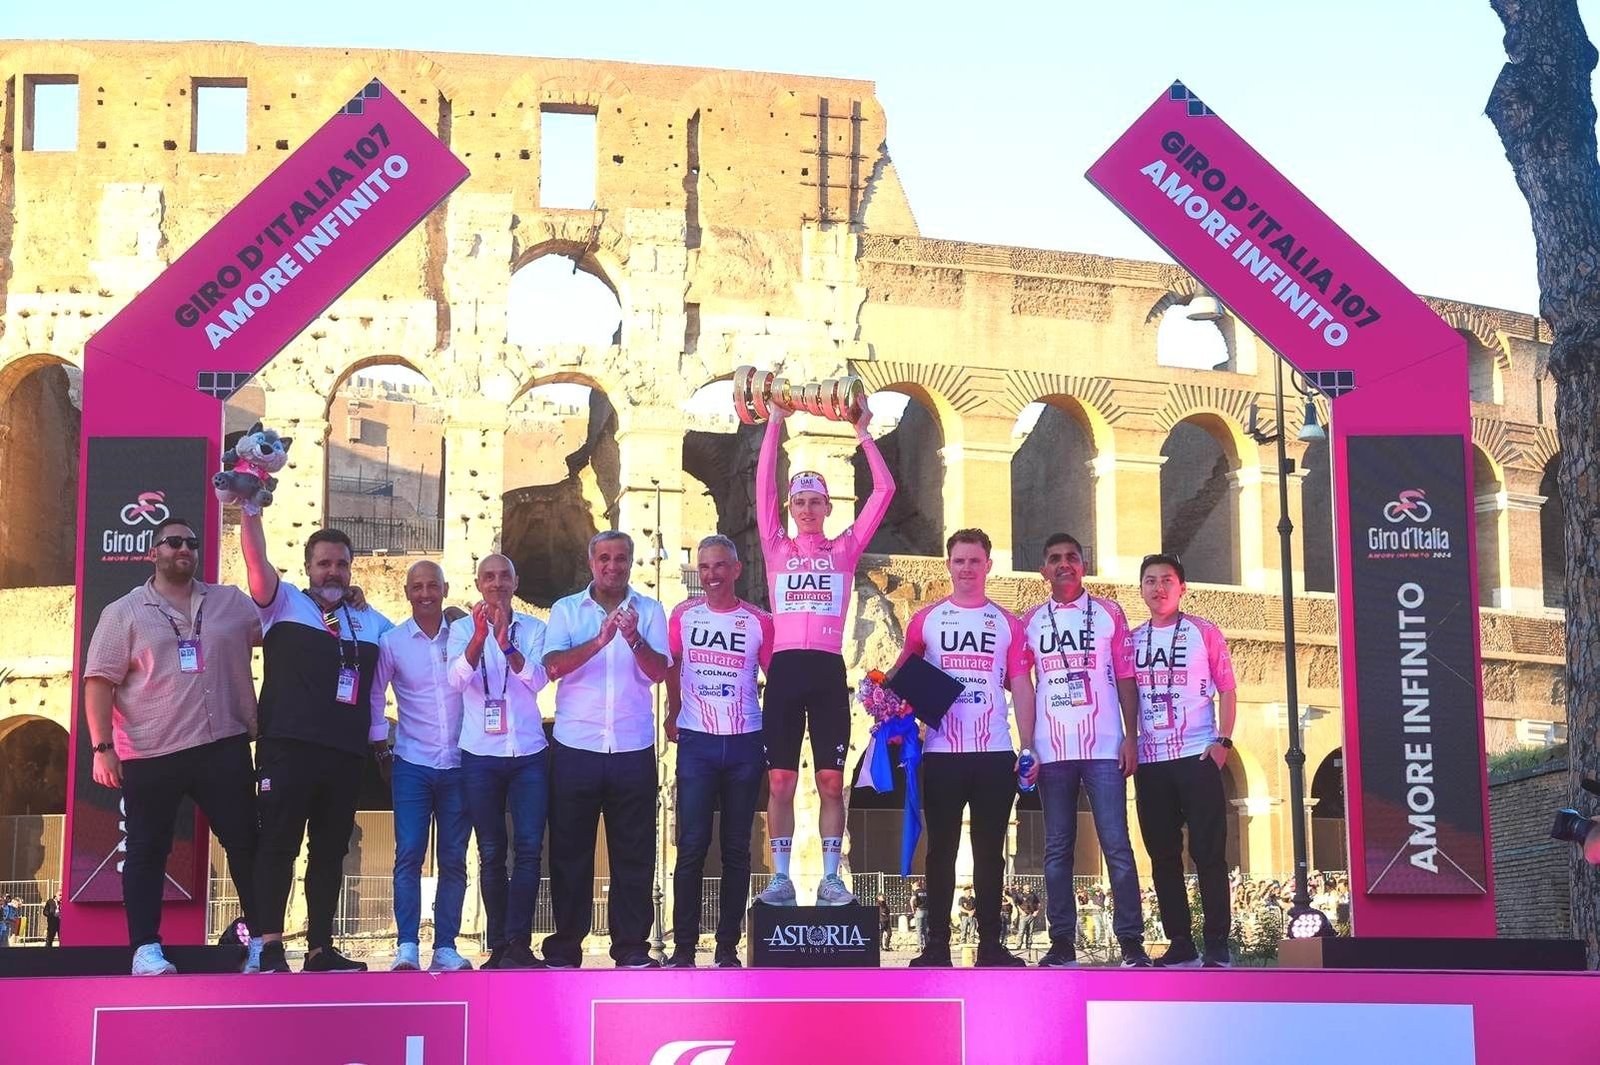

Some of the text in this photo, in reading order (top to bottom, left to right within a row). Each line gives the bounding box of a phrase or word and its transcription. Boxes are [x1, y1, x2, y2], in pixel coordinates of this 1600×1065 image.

[175, 123, 391, 328] GIRO D'ITALIA 107
[1161, 131, 1382, 329] GIRO D'ITALIA 107
[203, 154, 409, 350] AMORE INFINITO
[1140, 159, 1348, 346] AMORE INFINITO
[103, 530, 133, 552] Giro
[1368, 527, 1449, 550] Giro d'Italia
[786, 555, 835, 571] enel
[787, 574, 831, 590] UAE
[786, 592, 831, 601] Emirates
[690, 627, 746, 653] UAE
[941, 631, 996, 654] UAE
[1040, 630, 1095, 653] UAE
[690, 650, 744, 667] Emirates
[943, 656, 992, 670] Emirates
[1136, 647, 1186, 668] UAE
[702, 669, 738, 678] COLNAGO
[955, 677, 987, 685] COLNAGO
[1397, 582, 1439, 873] AMORE INFINITO
[768, 925, 866, 946] ASTORIA
